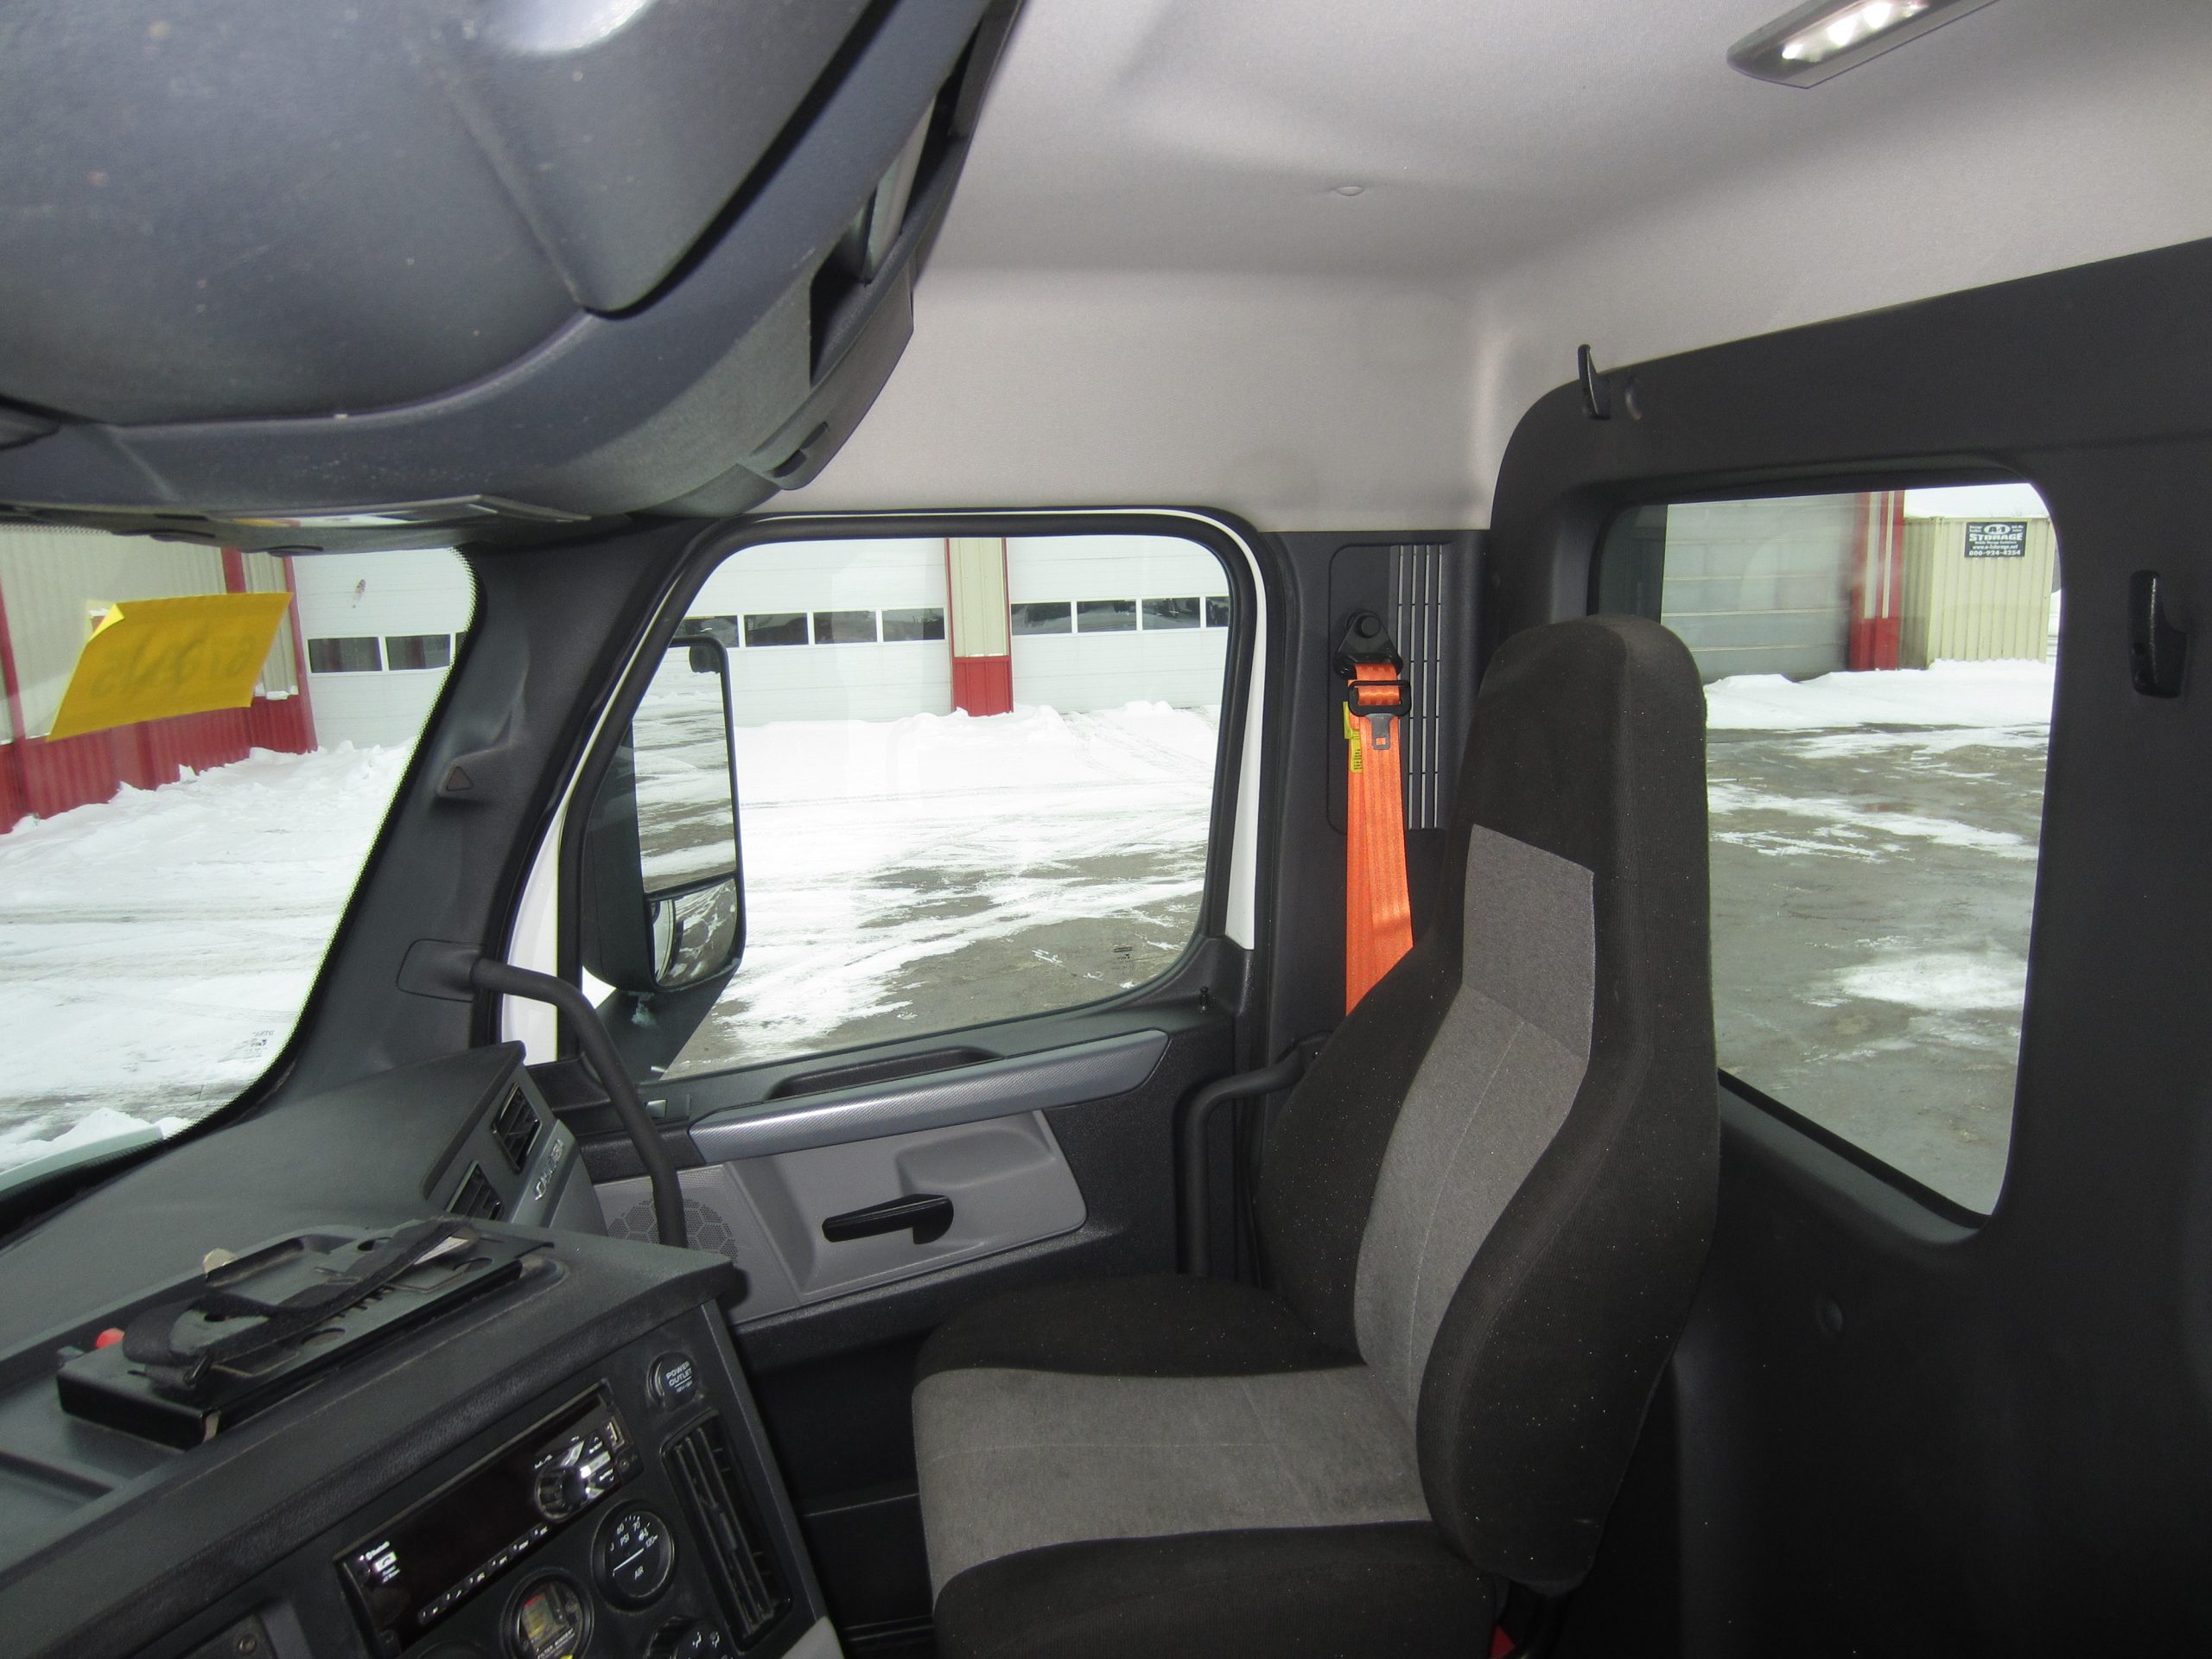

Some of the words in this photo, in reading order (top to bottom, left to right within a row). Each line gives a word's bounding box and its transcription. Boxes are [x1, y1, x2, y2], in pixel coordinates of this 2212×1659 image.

[1969, 532, 2023, 542] STORAGE
[666, 1361, 690, 1380] POWER
[669, 1367, 691, 1386] OUTLET
[620, 1533, 630, 1547] PSI
[634, 1566, 644, 1580] AIR
